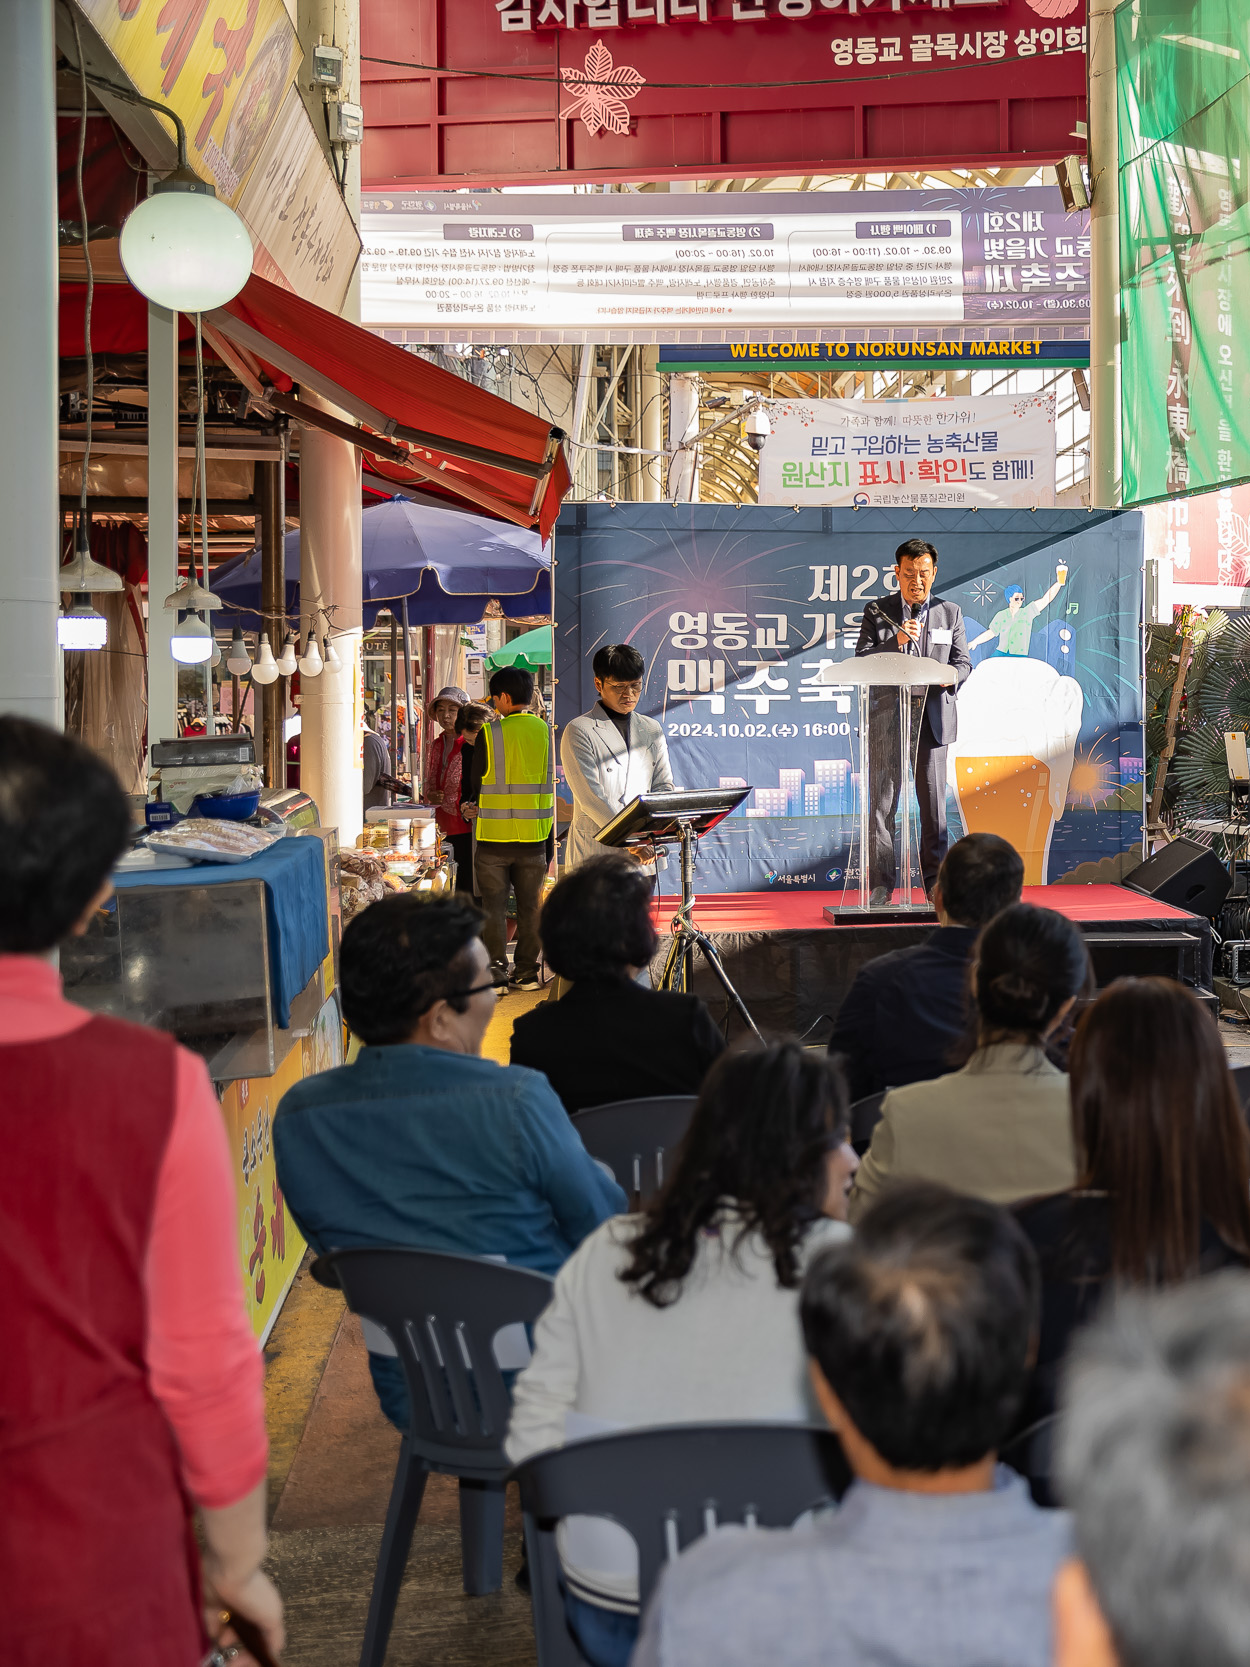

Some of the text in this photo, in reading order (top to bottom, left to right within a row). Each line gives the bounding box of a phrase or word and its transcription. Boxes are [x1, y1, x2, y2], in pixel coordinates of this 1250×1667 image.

[831, 25, 1087, 65] 영동교 골목시장 상인회
[730, 340, 1043, 360] WELCOME TO NORUNSAN MARKET
[840, 411, 976, 428] 가족과 함께! 따뜻한 한가위!
[812, 431, 999, 456] 믿고 구입하는 농축산물
[781, 458, 1034, 489] 원산지 표시·확인도 함께!
[873, 492, 965, 505] 국립농산물품질관리원
[669, 612, 790, 650] 영동교
[667, 658, 855, 715] 맥주축
[668, 722, 850, 738] 2024.10.02.(수) 16:00
[777, 873, 816, 884] 서울특별시
